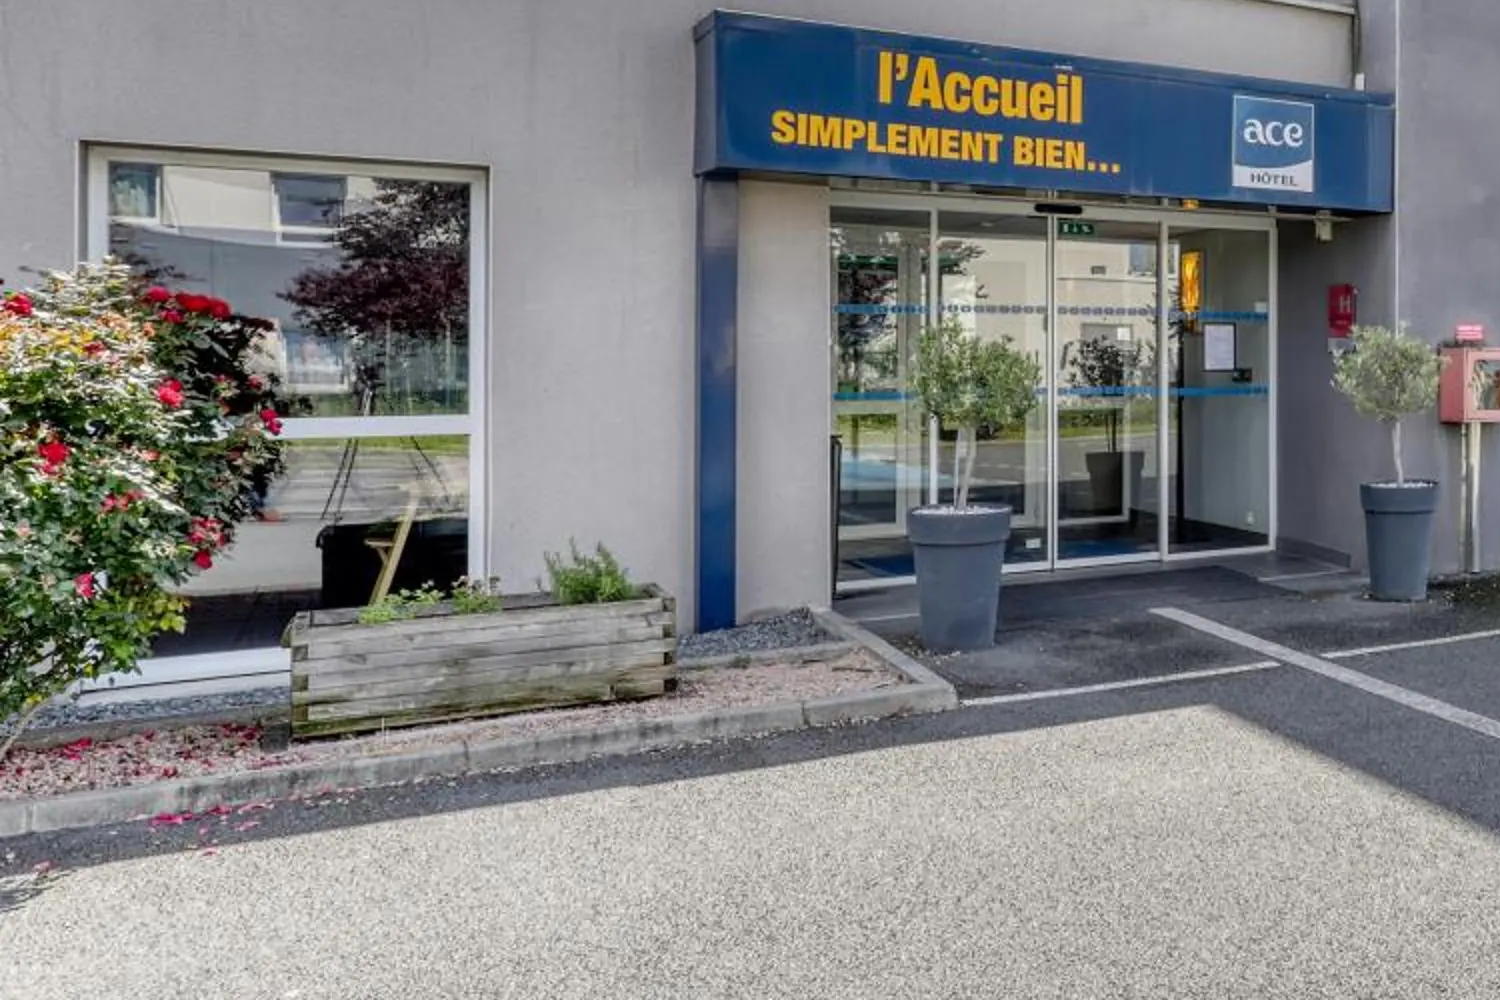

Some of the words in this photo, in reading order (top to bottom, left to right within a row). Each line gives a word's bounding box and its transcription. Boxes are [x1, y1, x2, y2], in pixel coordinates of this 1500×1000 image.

[878, 51, 1083, 124] l'Accueil
[771, 109, 1003, 163] SIMPLEMENT
[1012, 135, 1121, 173] BIEN...
[1243, 118, 1303, 147] ace
[1250, 171, 1298, 187] HÔTEL
